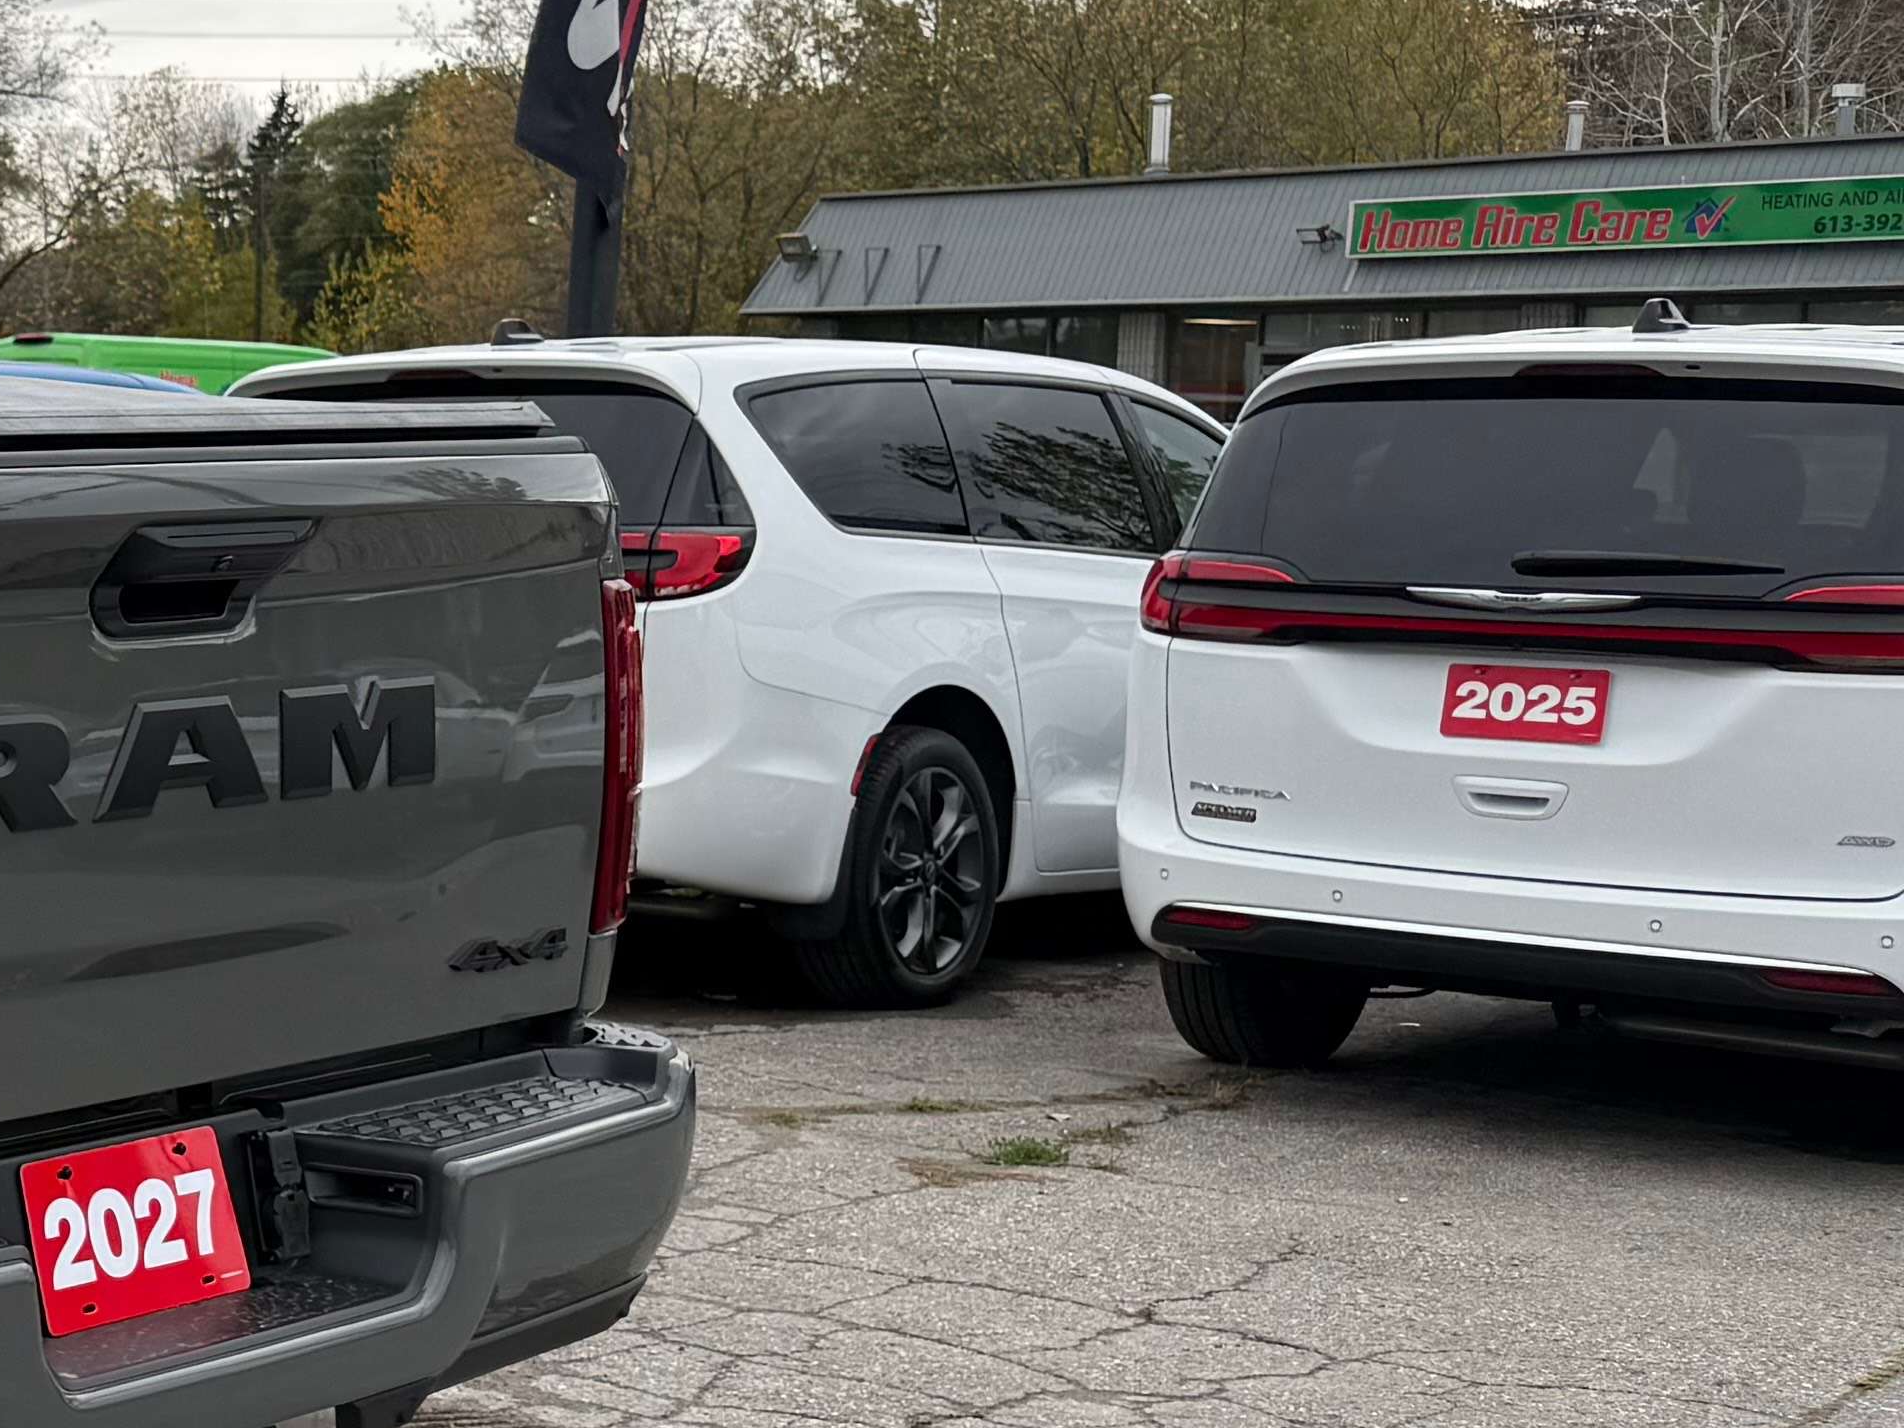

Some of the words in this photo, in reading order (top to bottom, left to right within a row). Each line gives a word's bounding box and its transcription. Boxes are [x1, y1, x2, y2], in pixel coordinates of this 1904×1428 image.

[1761, 192, 1833, 210] HEATING
[1839, 189, 1879, 206] AND
[1883, 188, 1904, 204] AI
[1357, 209, 1464, 252] Home
[1472, 204, 1560, 248] Aire
[1567, 200, 1673, 245] Care
[1451, 680, 1597, 725] 2025
[44, 1168, 215, 1291] 2027
